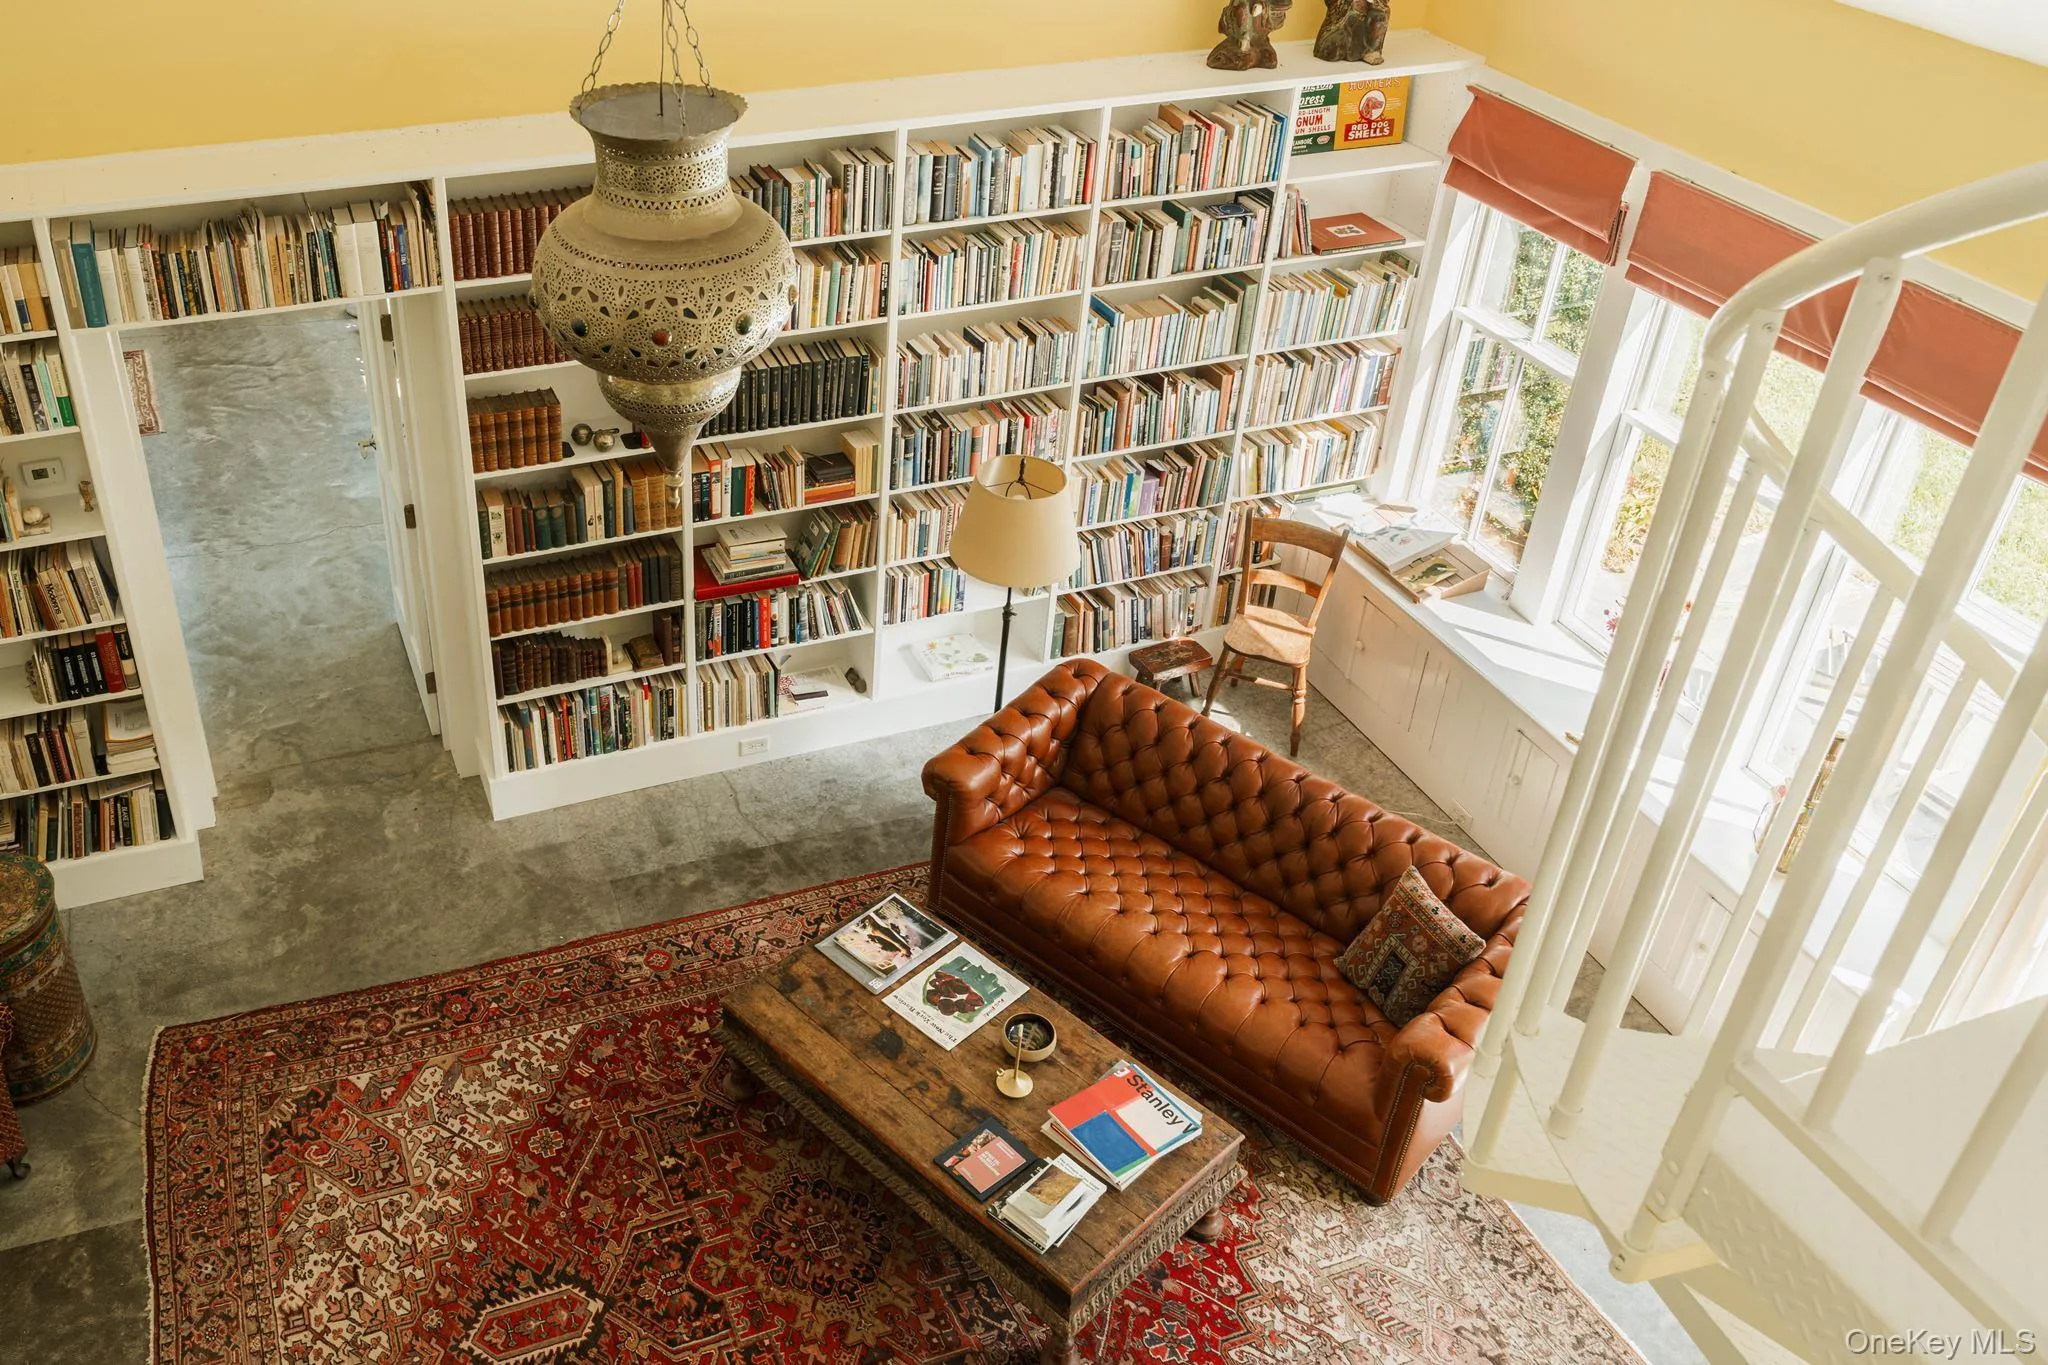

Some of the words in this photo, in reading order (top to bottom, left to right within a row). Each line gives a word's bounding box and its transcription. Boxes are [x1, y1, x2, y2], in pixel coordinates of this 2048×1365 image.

[1296, 114, 1322, 128] GNUM
[1351, 122, 1368, 132] RED
[1371, 120, 1389, 128] DOG
[1308, 124, 1331, 133] SHELLS
[1348, 126, 1390, 140] SHELLS
[44, 583, 63, 615] Moderns
[892, 994, 916, 1013] Review
[915, 1011, 931, 1024] York
[930, 1021, 945, 1034] New
[944, 1032, 958, 1043] The
[1127, 1073, 1184, 1126] Stanley
